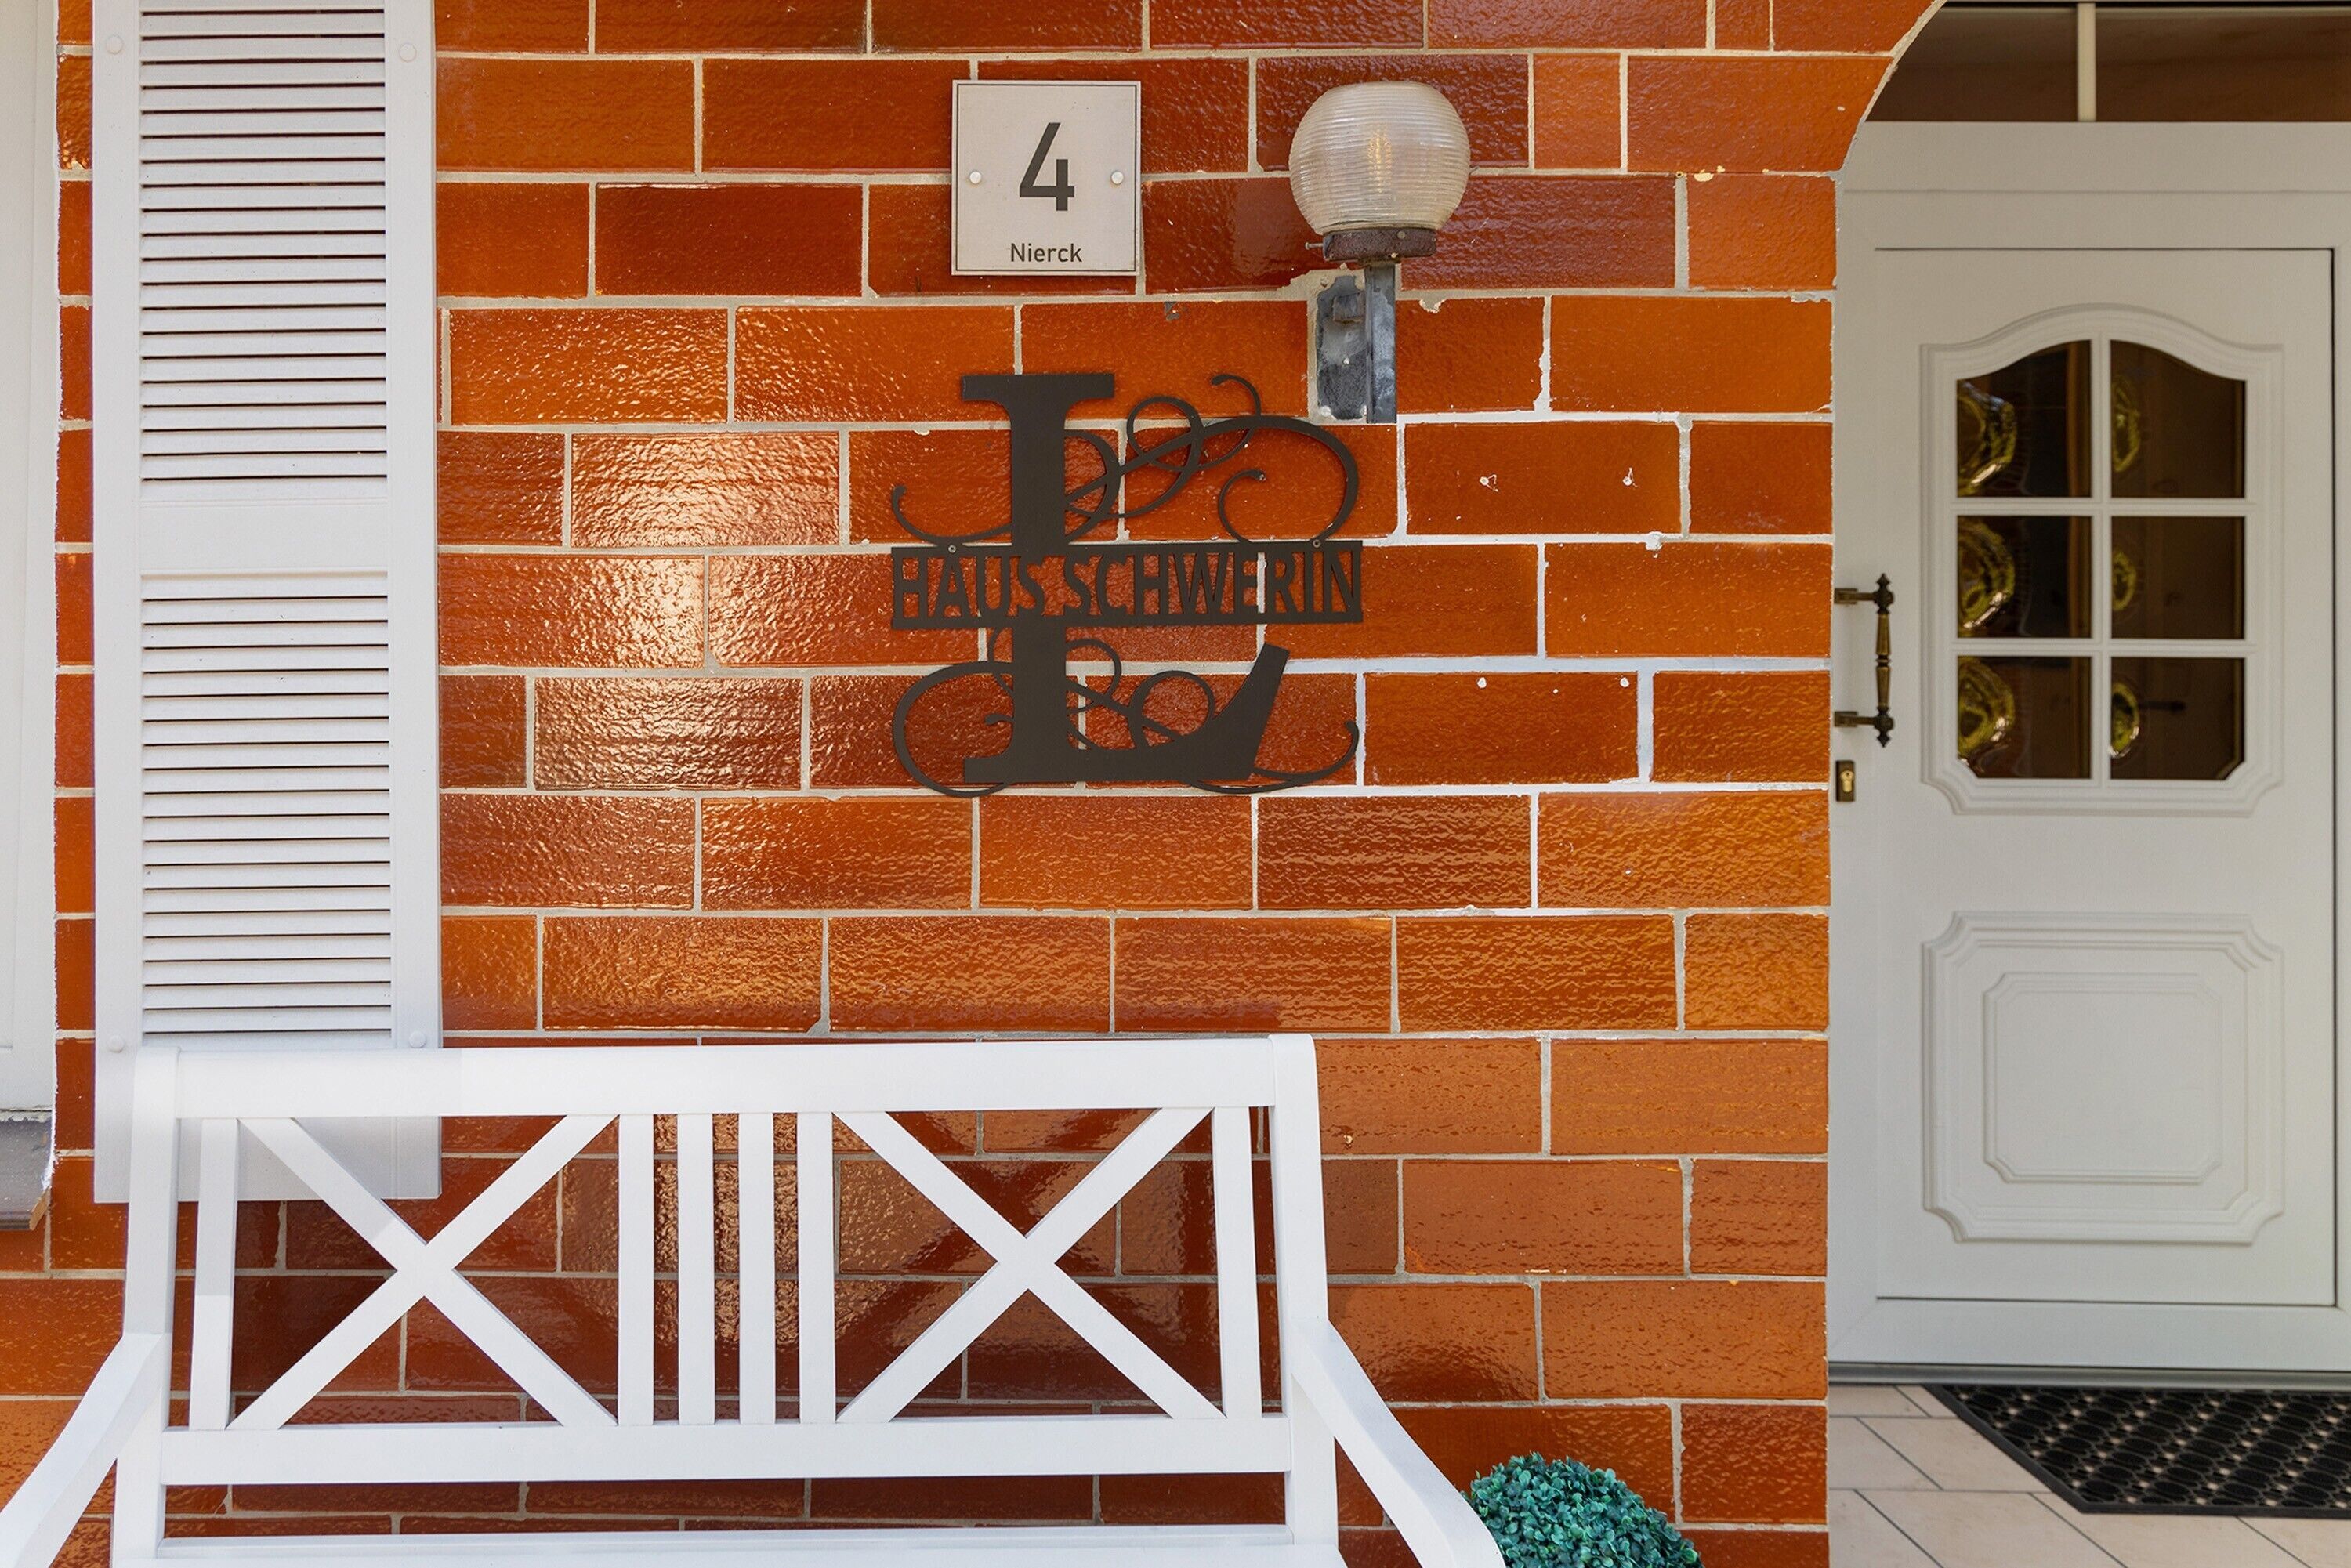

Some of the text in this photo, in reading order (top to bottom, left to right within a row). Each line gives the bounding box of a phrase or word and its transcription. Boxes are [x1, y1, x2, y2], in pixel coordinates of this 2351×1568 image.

[1020, 122, 1074, 211] 4
[1010, 242, 1083, 263] Nierck
[893, 550, 1361, 620] HAUS SCHWERIN
